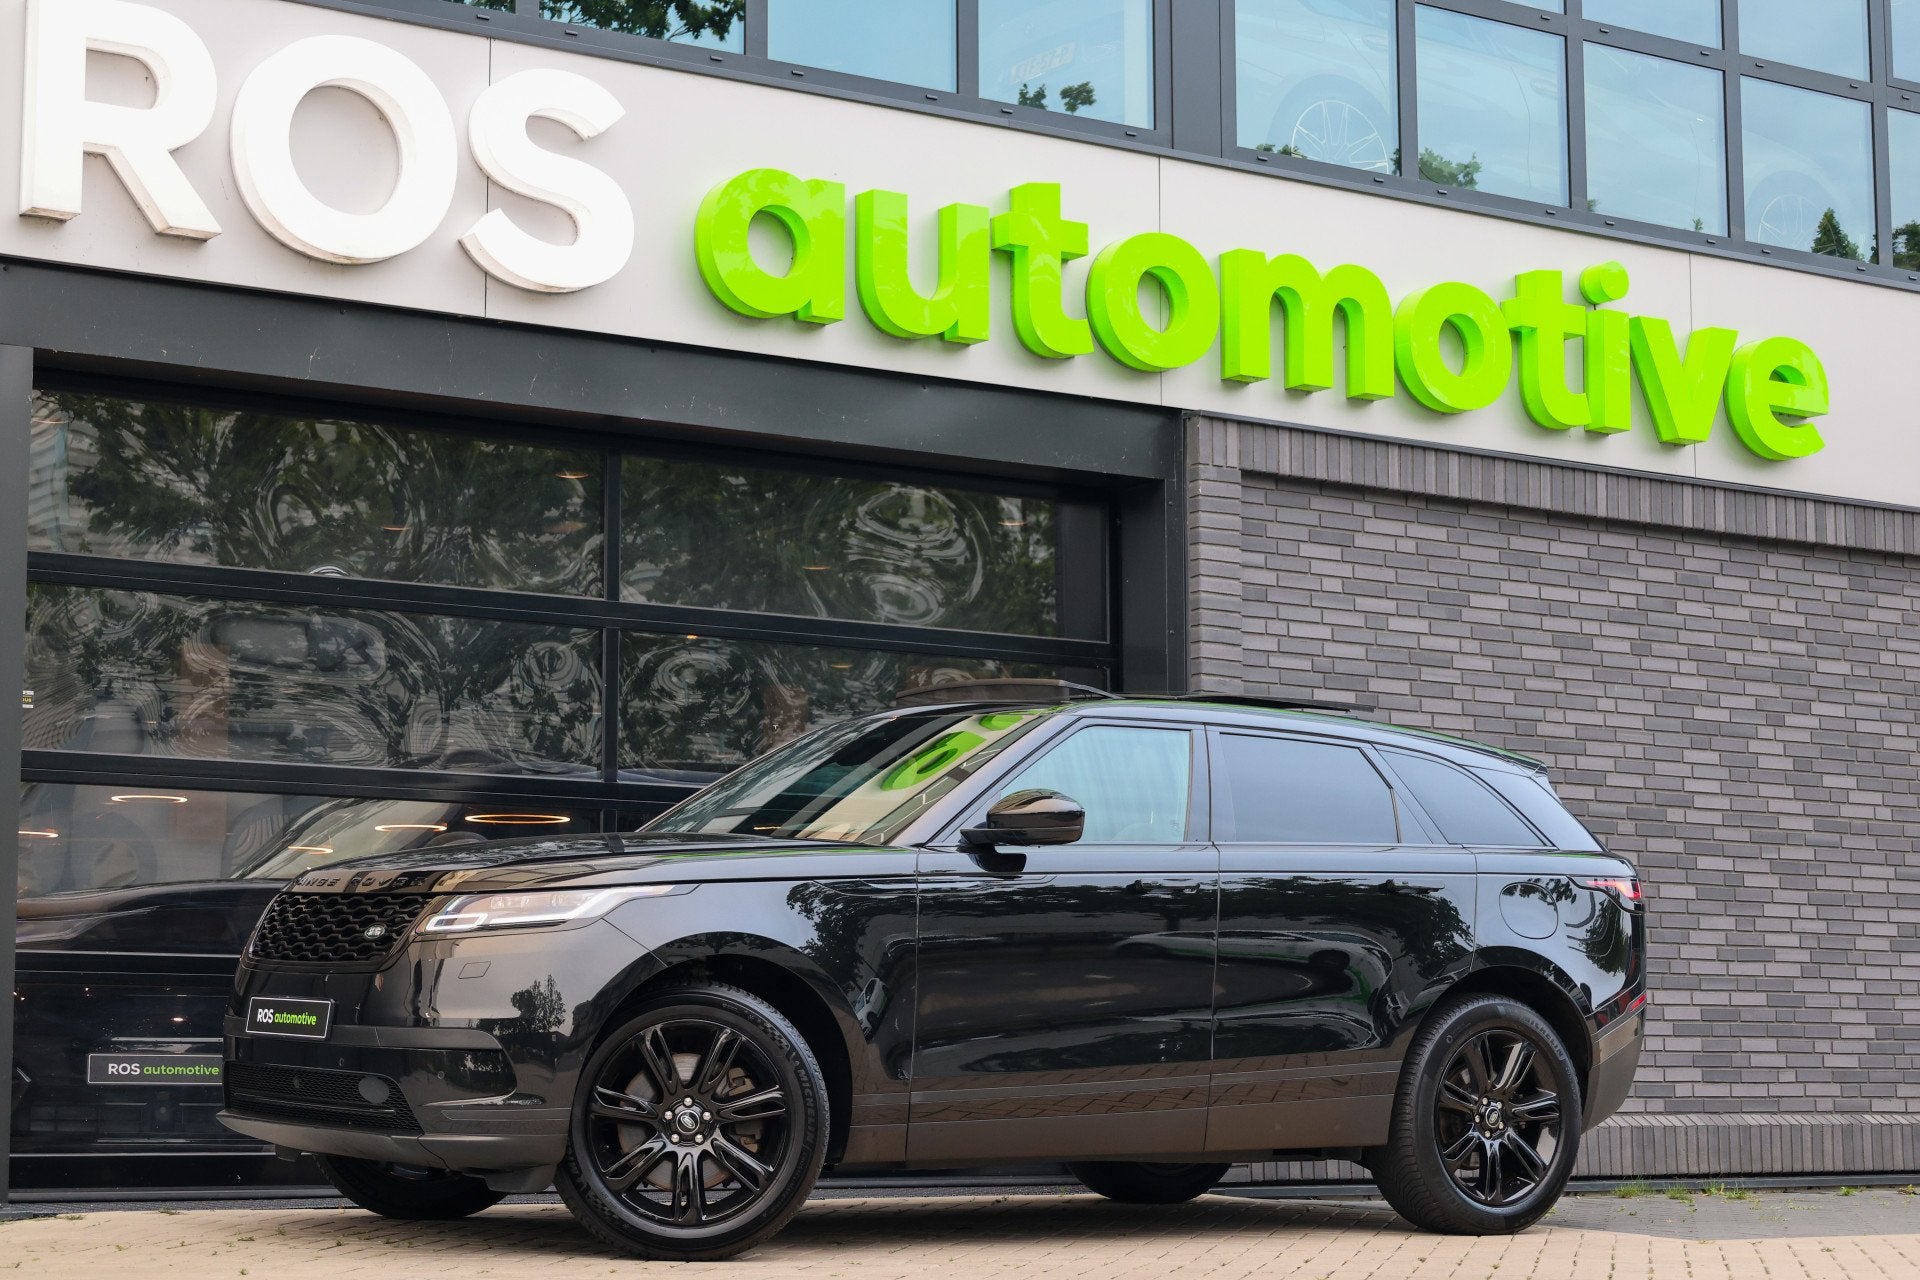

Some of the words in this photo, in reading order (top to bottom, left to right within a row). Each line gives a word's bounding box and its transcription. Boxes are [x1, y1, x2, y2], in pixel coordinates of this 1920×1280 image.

[19, 0, 635, 294] ROS
[694, 167, 1829, 461] automotive
[293, 876, 340, 888] ANGE
[256, 1008, 274, 1024] ROS
[274, 1011, 317, 1026] automotive
[108, 1063, 140, 1075] ROS
[143, 1064, 220, 1075] automotive
[797, 1068, 818, 1146] MICHELIN
